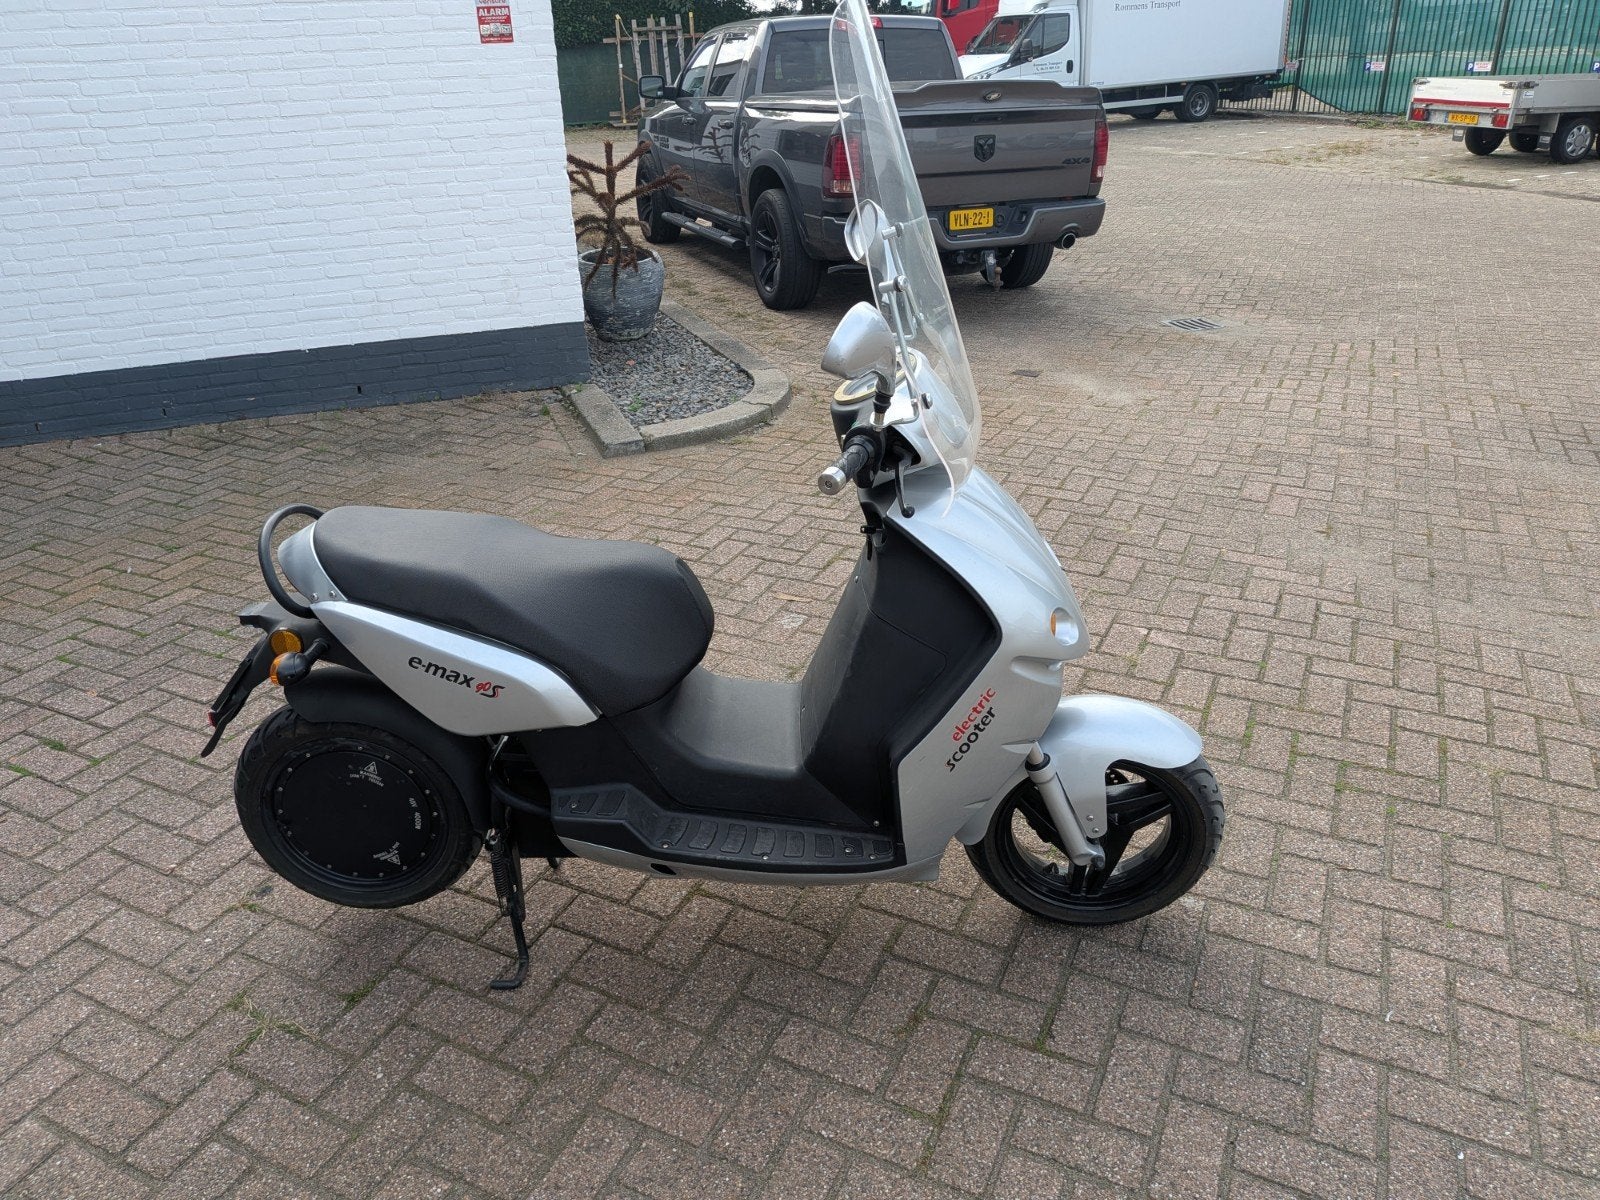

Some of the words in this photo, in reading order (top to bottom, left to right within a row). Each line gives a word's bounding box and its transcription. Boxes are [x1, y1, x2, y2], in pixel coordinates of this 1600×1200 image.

[479, 7, 510, 17] ALARM
[1150, 0, 1181, 10] Transport
[953, 211, 990, 227] VLN-22-J
[408, 656, 475, 688] e-max
[952, 687, 996, 741] electric
[945, 706, 996, 773] scooter
